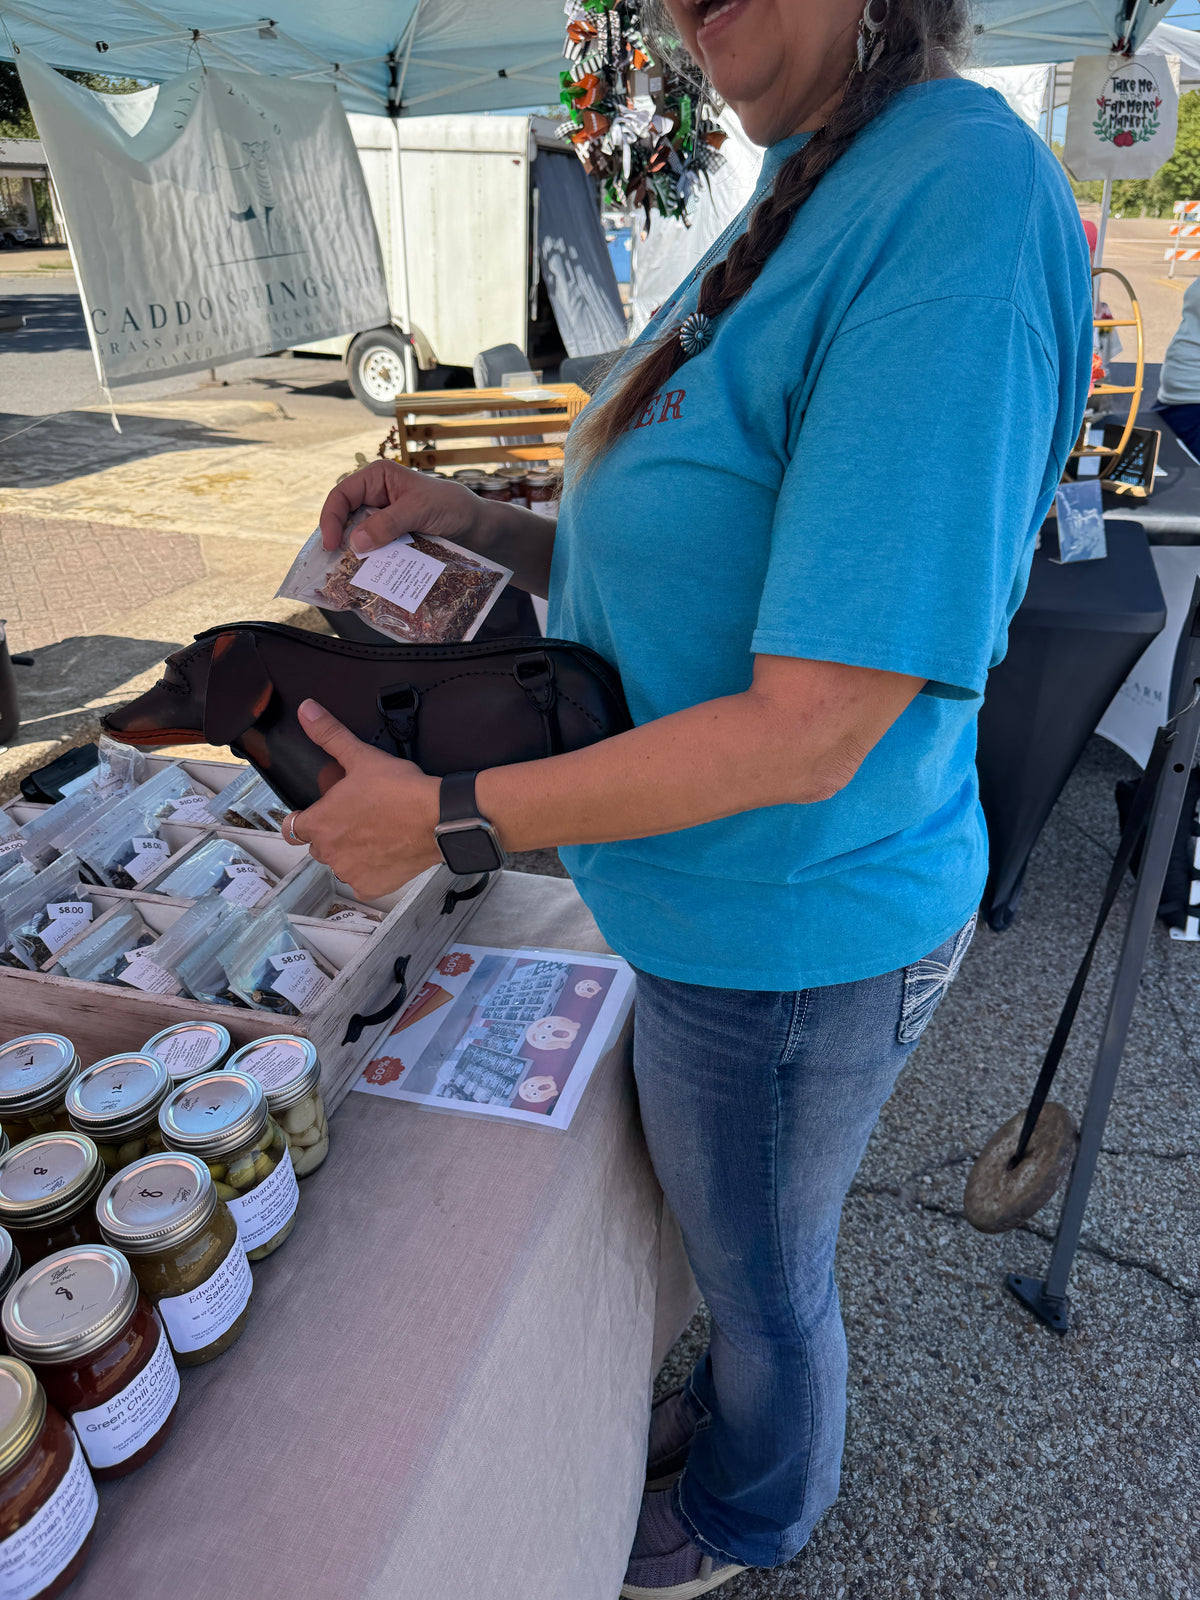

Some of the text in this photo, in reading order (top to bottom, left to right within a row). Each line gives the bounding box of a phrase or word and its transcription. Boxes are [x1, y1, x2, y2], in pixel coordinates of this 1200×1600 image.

[1109, 76, 1136, 93] Take
[1108, 113, 1147, 129] Market
[91, 297, 213, 336] CADDO
[1124, 682, 1162, 702] ARM
[58, 906, 84, 915] $8.00
[281, 953, 306, 965] $8.00
[444, 955, 461, 973] 50%
[371, 1060, 391, 1081] 50%
[205, 1104, 221, 1115] 12
[241, 1179, 275, 1208] Edwards
[260, 1184, 281, 1206] Pickled
[55, 1286, 73, 1301] 8
[188, 1270, 226, 1304] Edwards
[205, 1277, 230, 1304] Salsa
[106, 1373, 149, 1414] Edwards
[86, 1411, 125, 1433] Green
[127, 1385, 149, 1412] Chili
[30, 1515, 61, 1550] Than
[61, 1481, 83, 1517] Heck
[3, 1506, 55, 1556] Edwards
